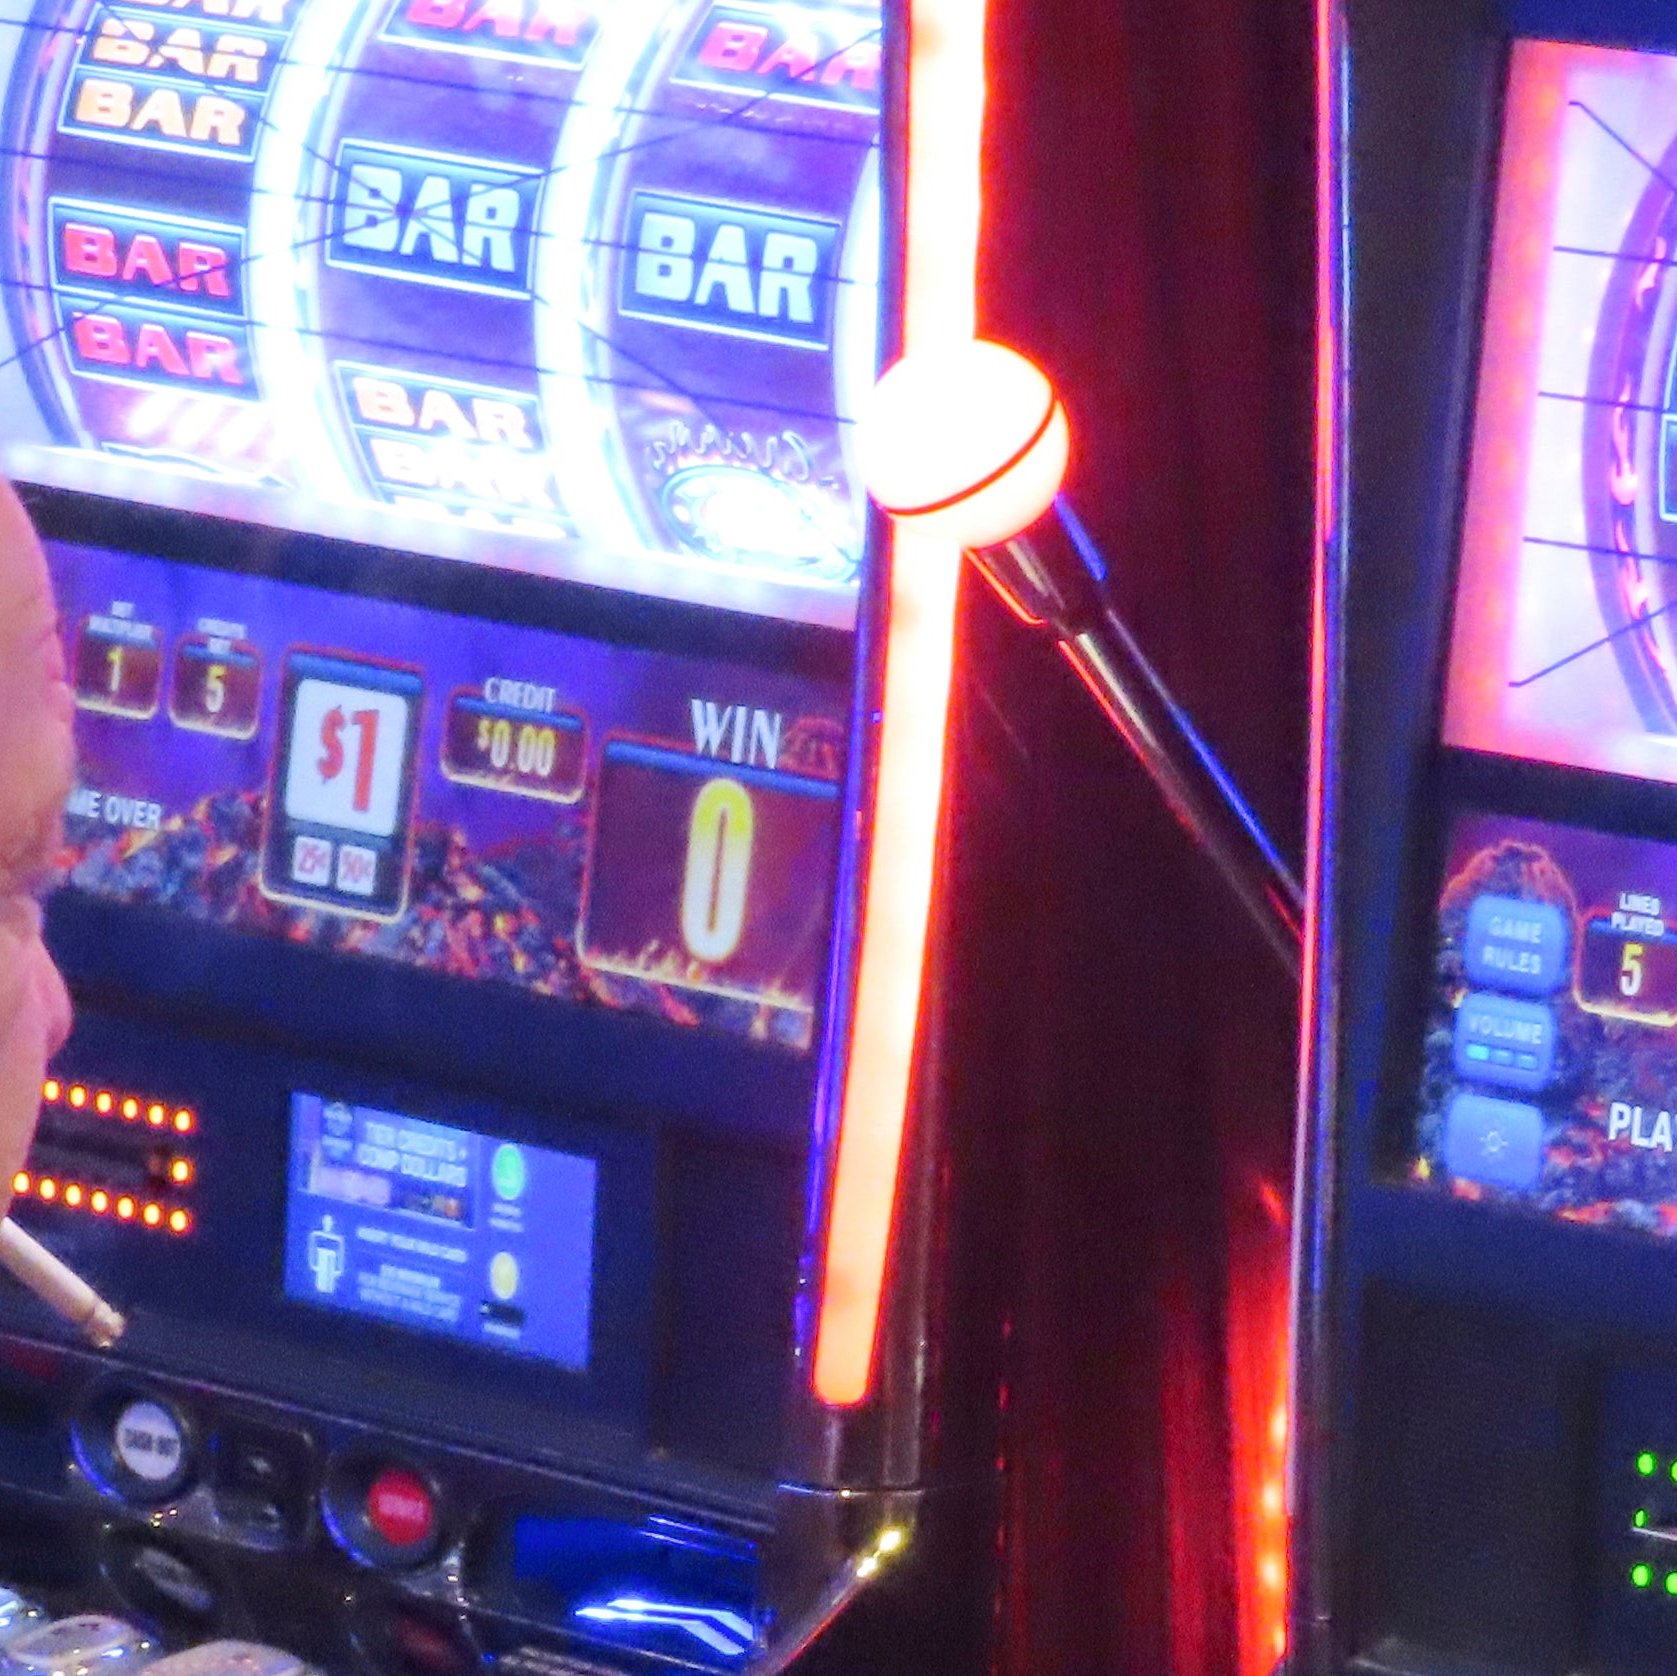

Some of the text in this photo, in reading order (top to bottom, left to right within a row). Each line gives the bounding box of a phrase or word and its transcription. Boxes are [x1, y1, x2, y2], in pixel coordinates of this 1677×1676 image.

[93, 18, 268, 83] BAR
[76, 78, 246, 146] BAR
[343, 162, 520, 272] BAR
[63, 222, 231, 298] BAR
[636, 212, 819, 324] BAR
[72, 311, 244, 385] BAR
[353, 376, 535, 449] BAR
[107, 645, 123, 692] 1
[205, 664, 227, 713] 5
[485, 677, 556, 713] CREDIT
[317, 704, 381, 813] $1
[477, 717, 557, 777] $0.00
[691, 699, 782, 770] WIN
[104, 795, 162, 830] OVER
[681, 777, 754, 963] 0
[1482, 945, 1542, 975] RULES
[1489, 916, 1543, 944] GAME
[1619, 942, 1644, 997] 5
[1470, 1013, 1542, 1045] VOLUME
